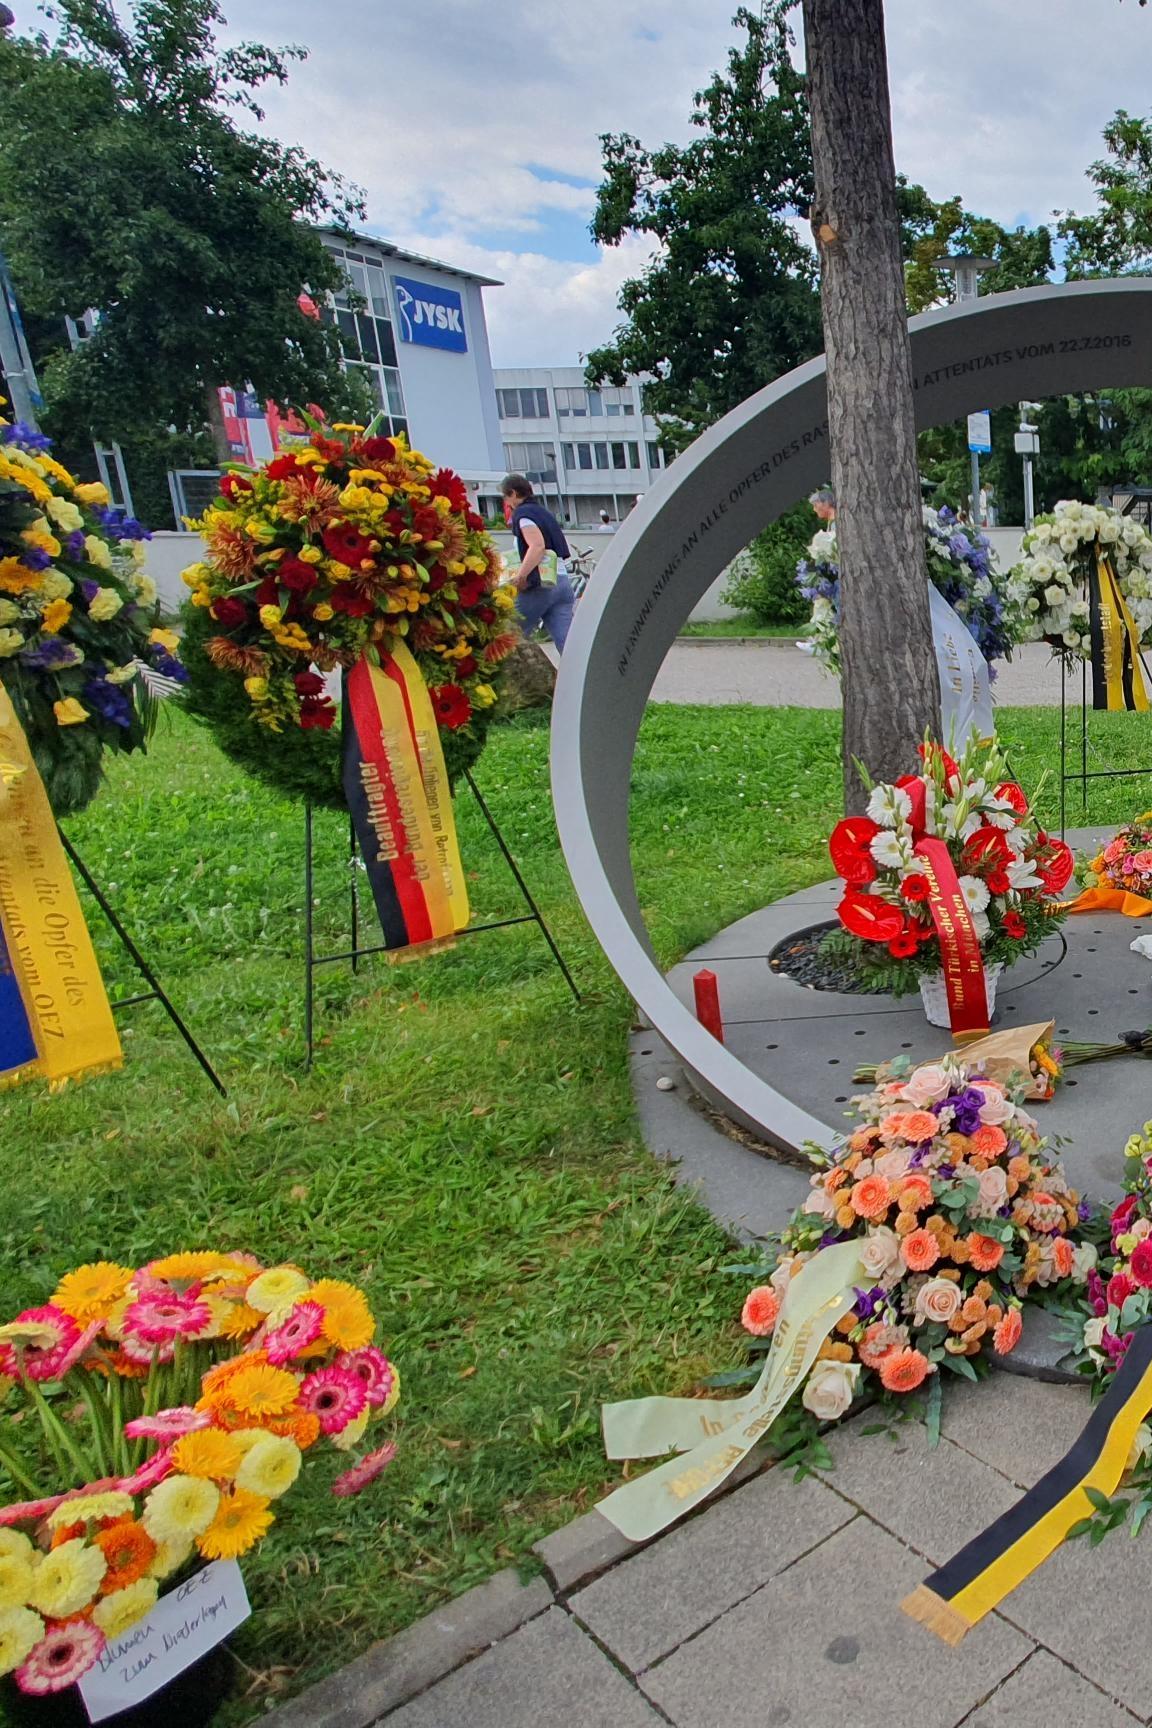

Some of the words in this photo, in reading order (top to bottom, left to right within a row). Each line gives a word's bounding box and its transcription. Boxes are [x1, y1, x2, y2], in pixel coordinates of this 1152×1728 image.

[413, 299, 462, 333] JYSK
[922, 350, 1013, 388] ATTENTATS
[1015, 341, 1055, 361] VOM
[1058, 334, 1133, 354] 22.7.2016
[681, 531, 699, 560] AN
[700, 501, 728, 536] ALLE
[728, 461, 772, 504] OPFER
[772, 440, 801, 468] DES
[359, 762, 400, 863] Beauftragter
[32, 877, 61, 906] die
[410, 859, 431, 883] der
[921, 854, 944, 904] Vereine
[42, 912, 79, 970] Opfer
[951, 894, 977, 955] München
[19, 944, 42, 988] vom
[35, 992, 65, 1039] OEZ
[63, 970, 89, 1007] des
[967, 960, 981, 974] in
